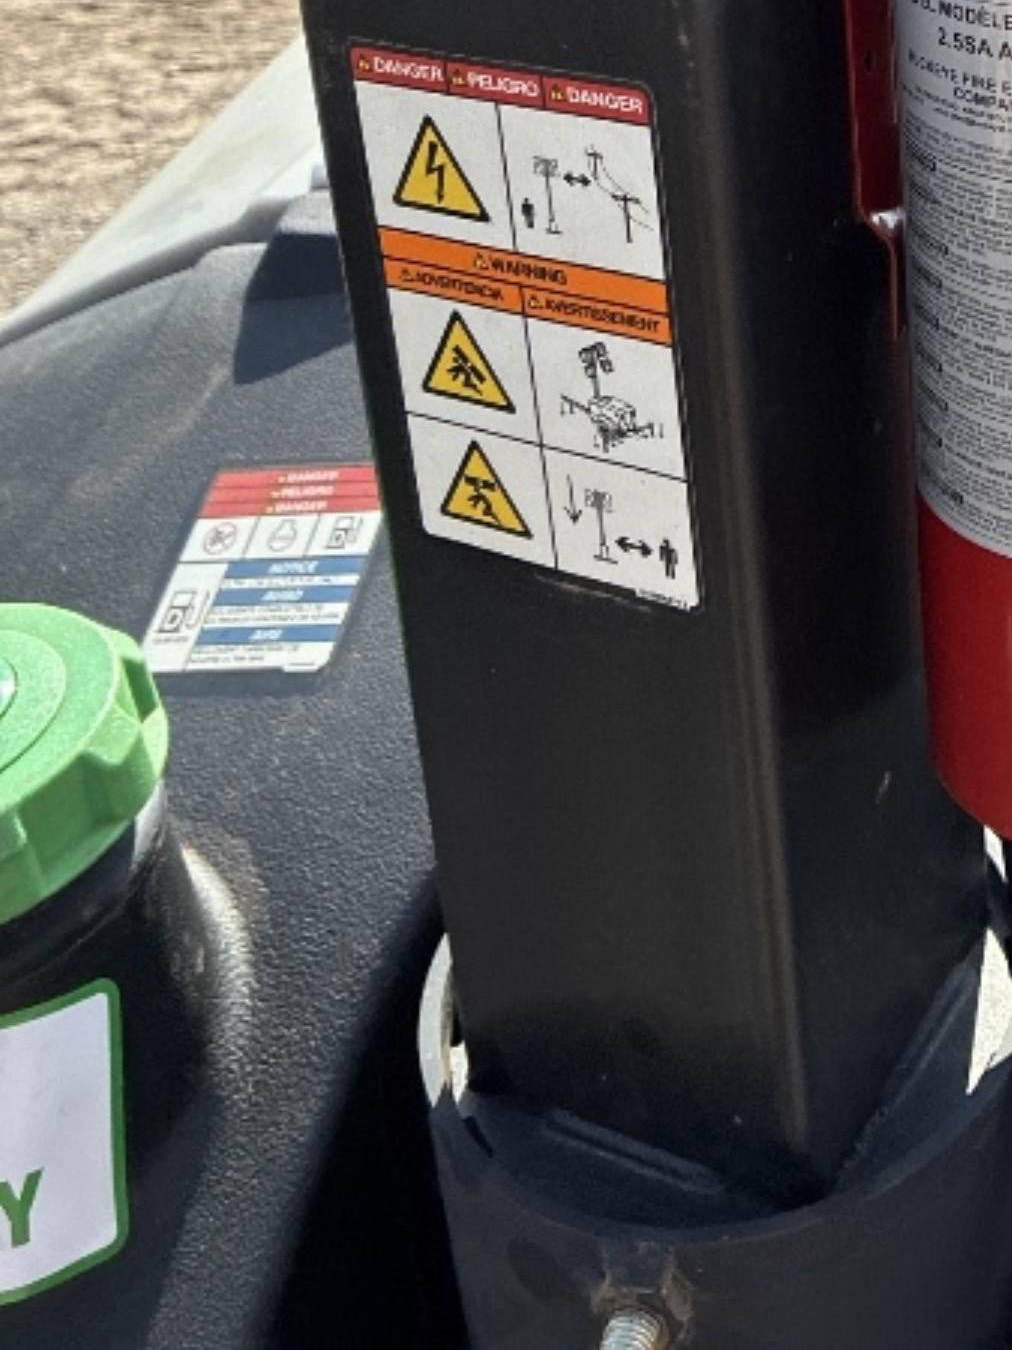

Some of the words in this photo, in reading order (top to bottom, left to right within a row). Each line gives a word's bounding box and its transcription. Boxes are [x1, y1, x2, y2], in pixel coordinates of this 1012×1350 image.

[373, 55, 445, 83] DANGER
[467, 70, 540, 98] PELIGRO
[566, 85, 643, 114] DANGER
[488, 255, 568, 287] WARNING
